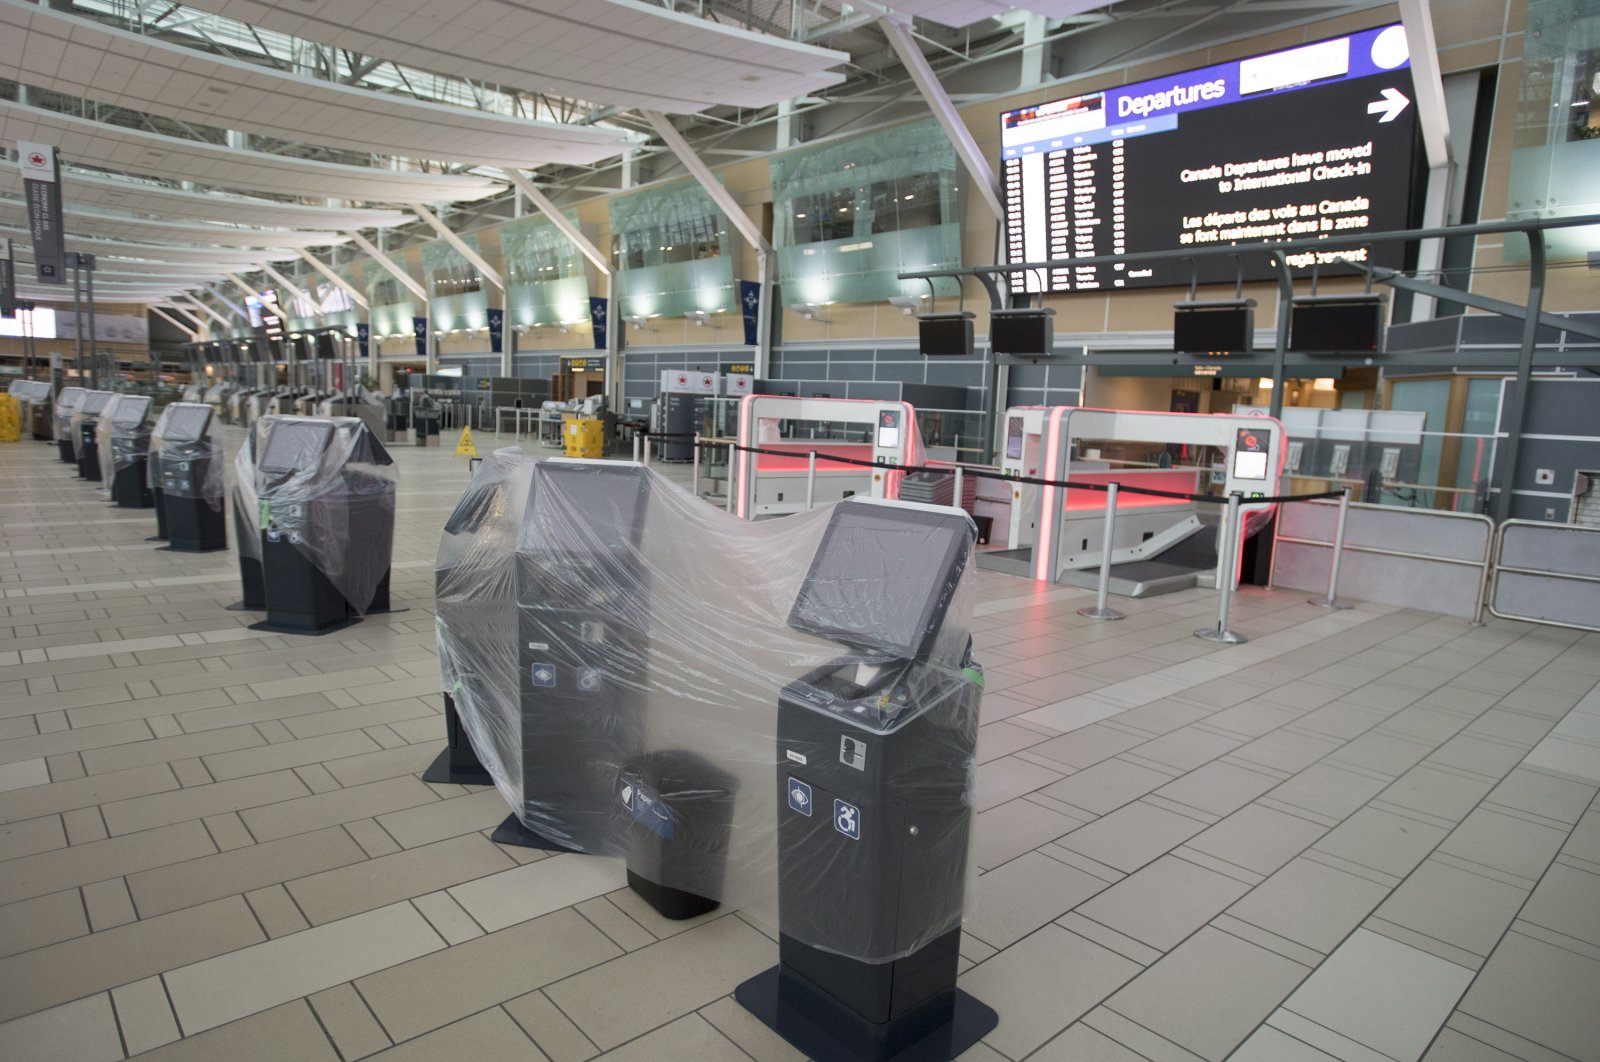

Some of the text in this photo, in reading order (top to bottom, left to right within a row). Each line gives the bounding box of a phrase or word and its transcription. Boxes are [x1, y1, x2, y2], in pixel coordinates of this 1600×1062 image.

[1118, 78, 1225, 117] Departures
[1181, 141, 1372, 183] Canada Departures have moved
[1218, 161, 1371, 193] to International Check-in
[1179, 232, 1194, 244] se
[1194, 227, 1218, 243] font
[1287, 218, 1318, 235] dans
[1320, 216, 1334, 231] la
[1335, 214, 1369, 230] zone
[1182, 216, 1203, 229] Les
[1248, 207, 1271, 222] des
[1271, 204, 1298, 219] vols
[1299, 202, 1317, 216] au
[1318, 196, 1369, 214] Canada
